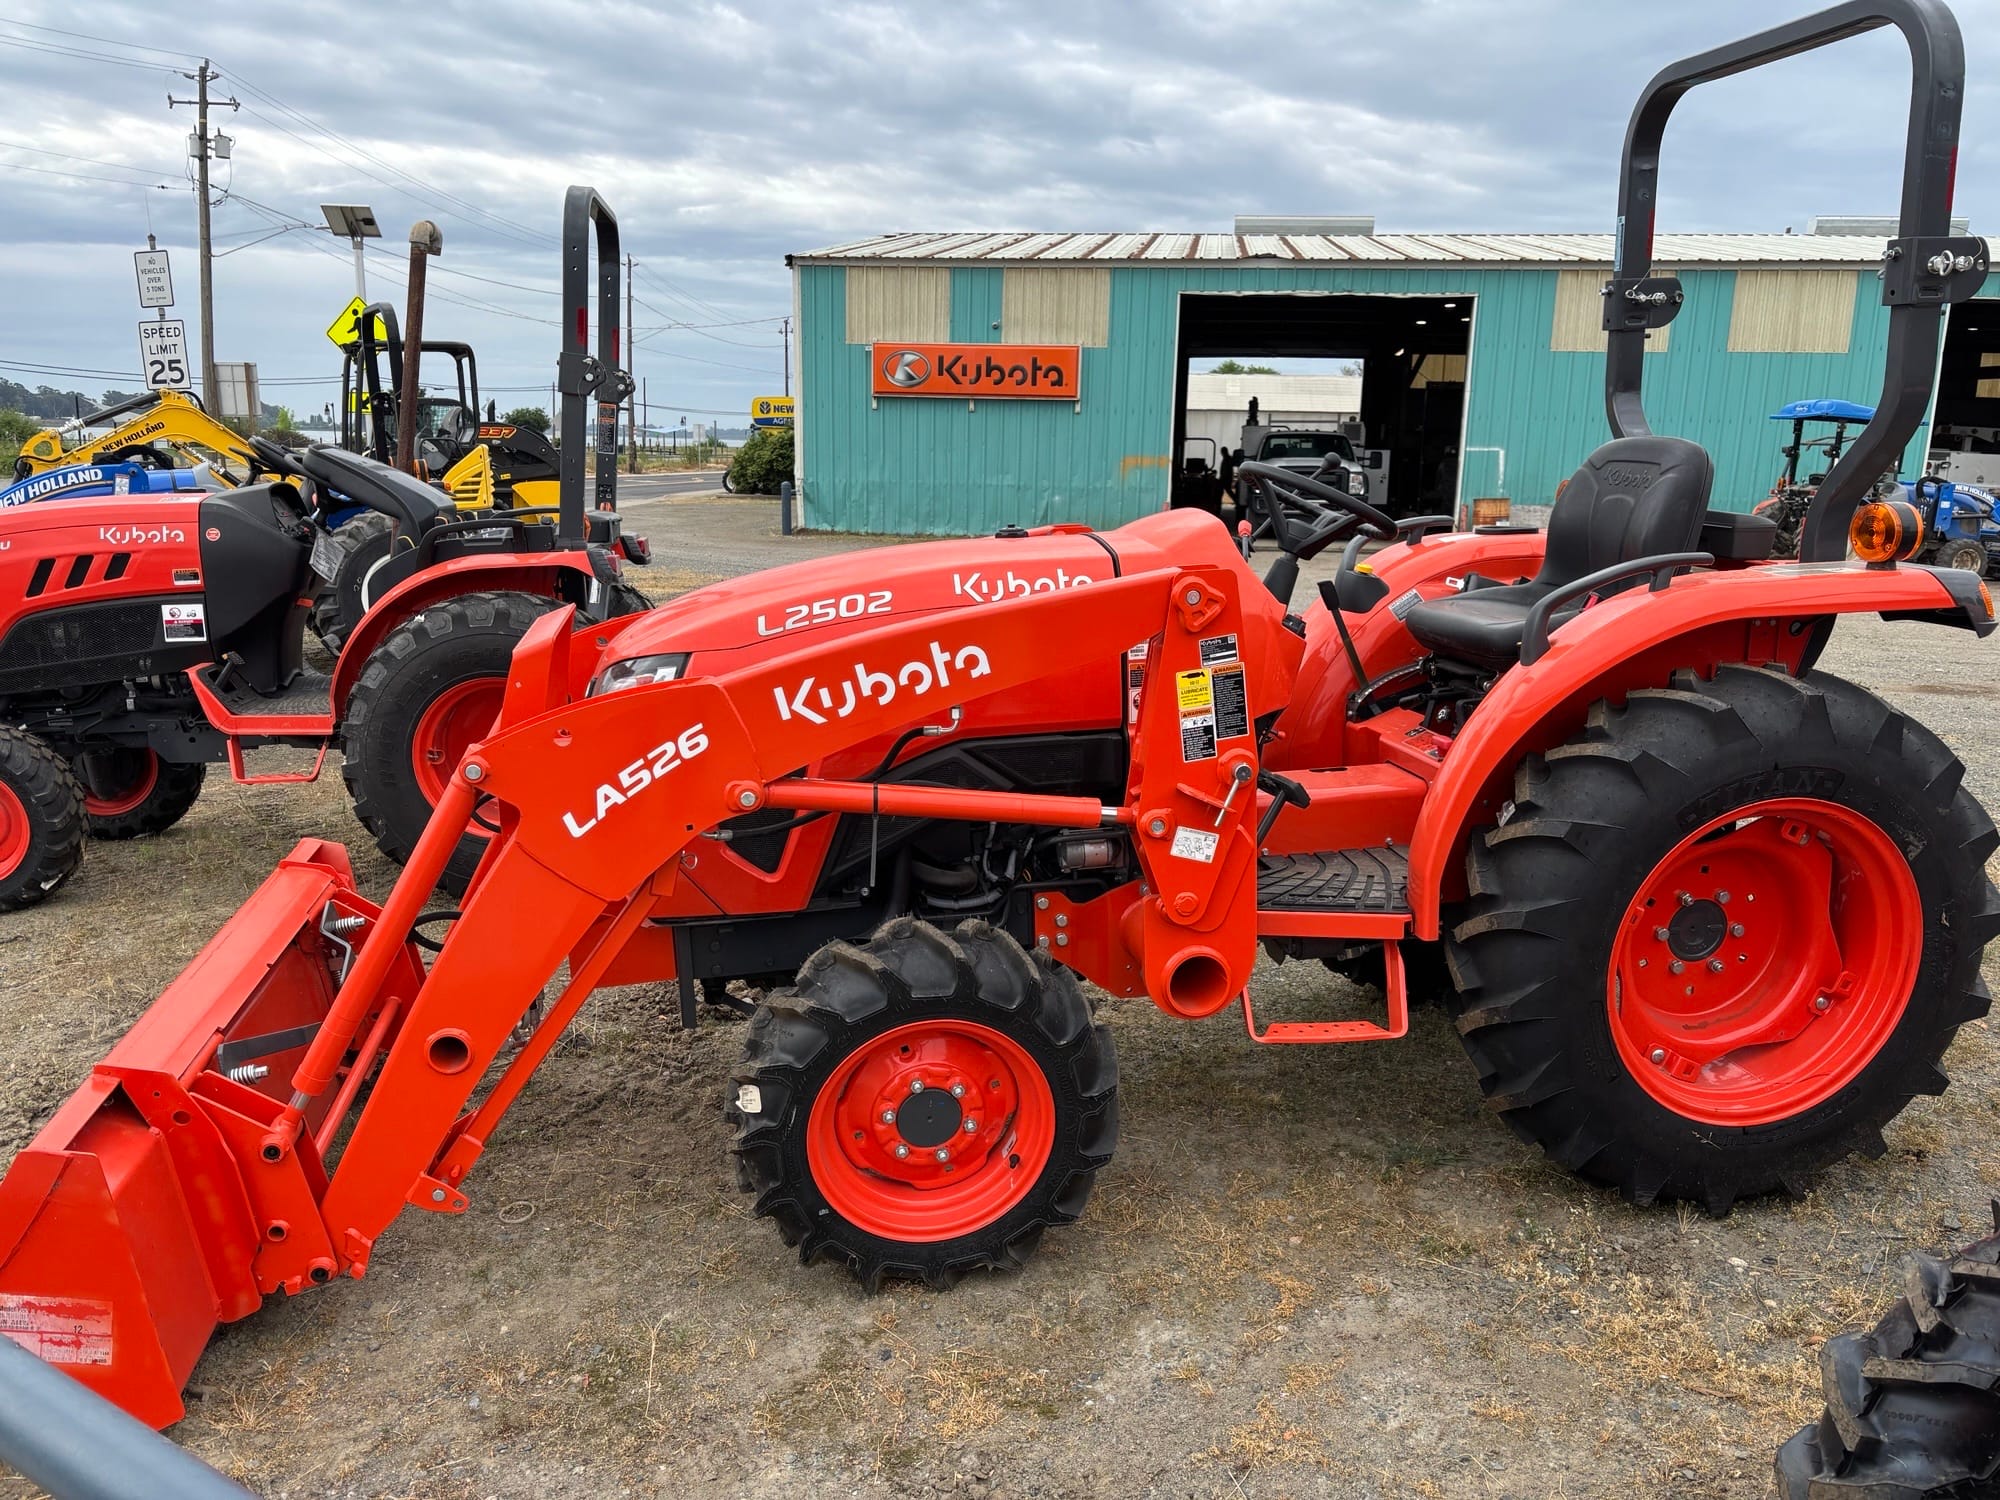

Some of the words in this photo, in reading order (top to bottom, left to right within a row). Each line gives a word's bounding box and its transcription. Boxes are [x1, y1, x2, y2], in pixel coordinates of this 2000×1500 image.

[143, 327, 181, 339] SPEED
[149, 343, 178, 355] LIMIT
[149, 359, 185, 385] 25
[937, 354, 1064, 387] Kubota
[773, 404, 795, 414] NEW
[102, 438, 124, 451] NEW
[123, 421, 165, 444] HOLLAND
[27, 468, 103, 499] HOLLAND
[1955, 484, 1970, 492] NEW
[1969, 487, 1996, 504] HOLLAND
[99, 524, 185, 545] Kubota
[757, 590, 893, 637] L2502
[772, 641, 992, 725] Kubota
[562, 722, 710, 838] LA526
